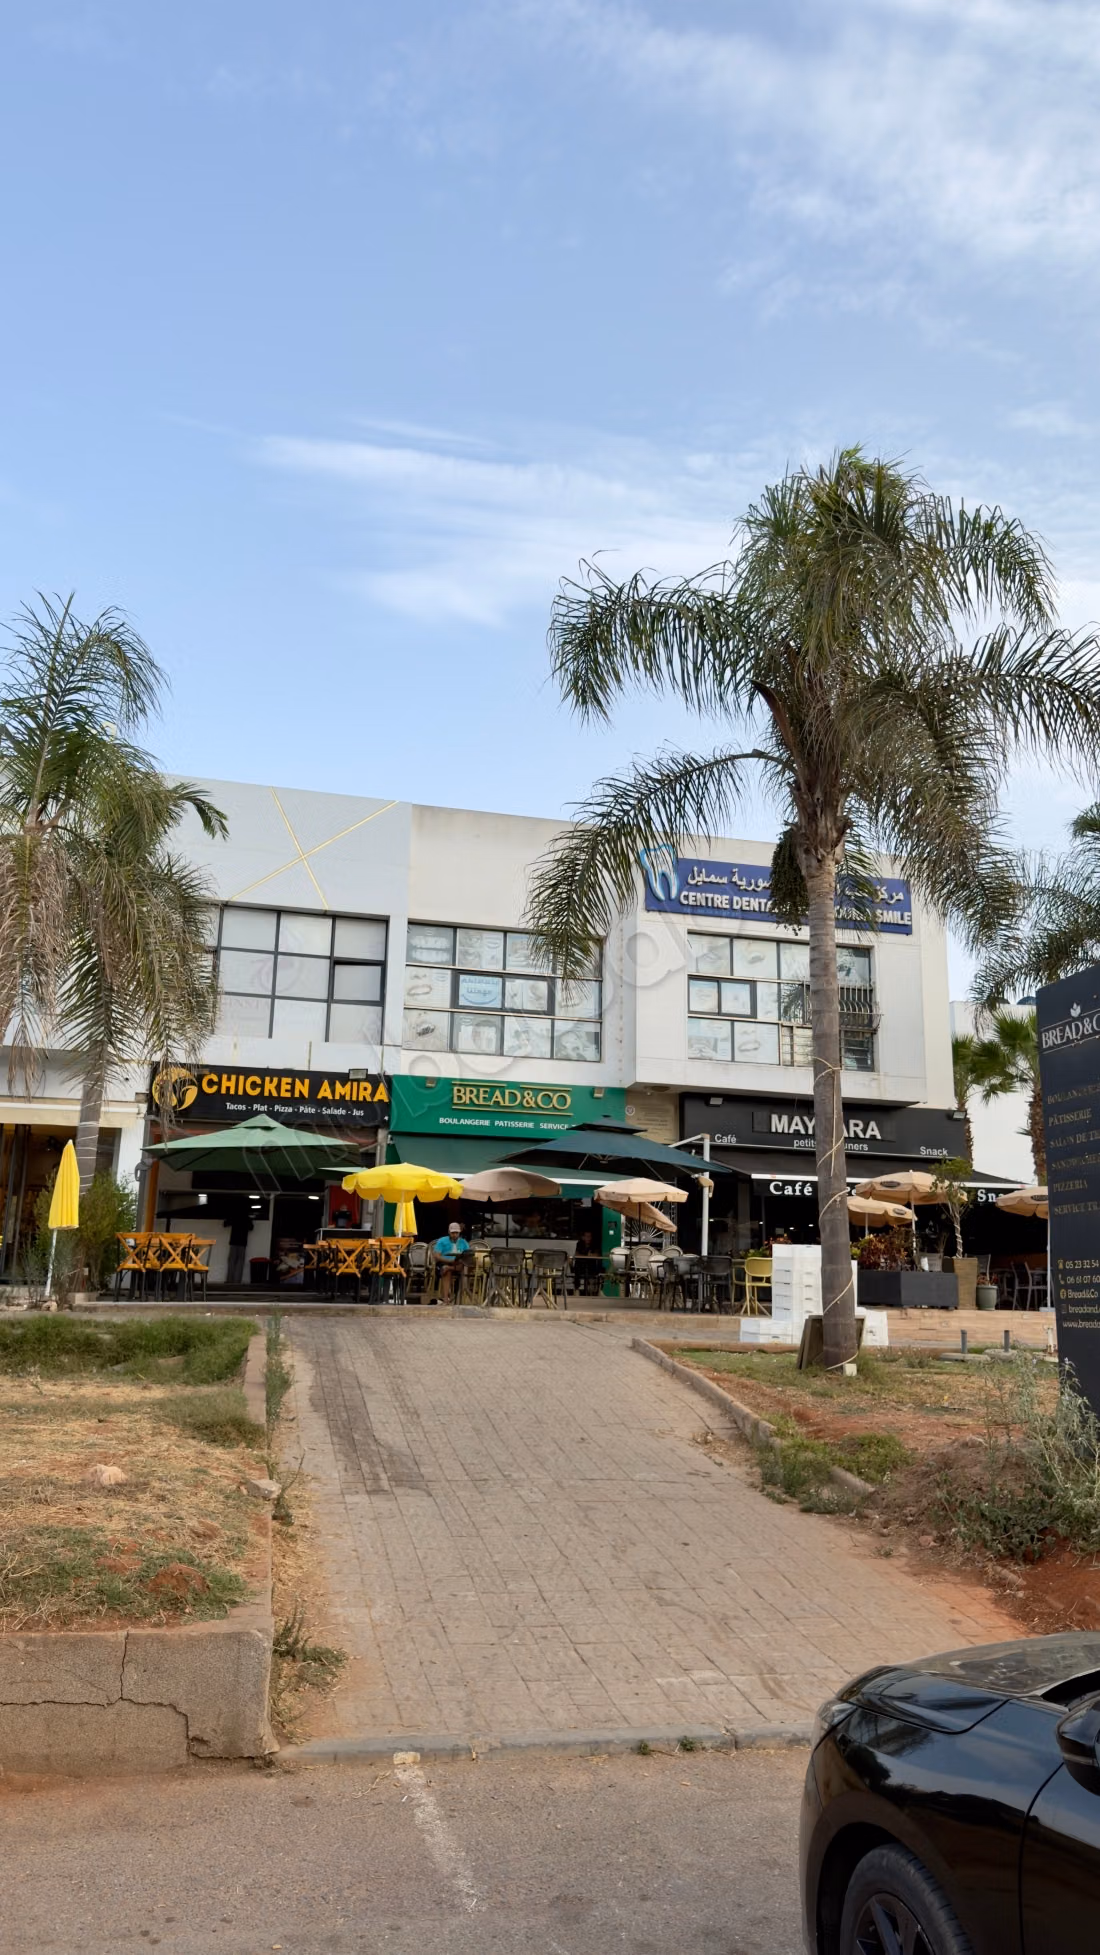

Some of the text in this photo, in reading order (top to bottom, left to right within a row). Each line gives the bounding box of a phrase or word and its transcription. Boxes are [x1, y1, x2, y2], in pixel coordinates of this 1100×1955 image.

[687, 865, 728, 886] سمايل
[680, 890, 730, 909] CENTRE
[875, 909, 912, 925] SMILE
[201, 1072, 390, 1103] CHICKEN AMIRA
[225, 1102, 247, 1111] Tacos
[252, 1103, 268, 1112] Plat
[274, 1104, 293, 1113] Pizza
[299, 1105, 316, 1114] Pâte
[322, 1106, 346, 1115] Salade
[352, 1108, 364, 1116] Jus
[439, 1117, 490, 1127] BOULANGERIE
[494, 1120, 535, 1129] PATISSERIE
[714, 1133, 737, 1144] Café
[1076, 1132, 1088, 1144] DE
[919, 1145, 948, 1156] Snack
[769, 1181, 813, 1196] Café
[1053, 1179, 1088, 1193] PIZZERIA
[1054, 1203, 1084, 1216] SERVICE
